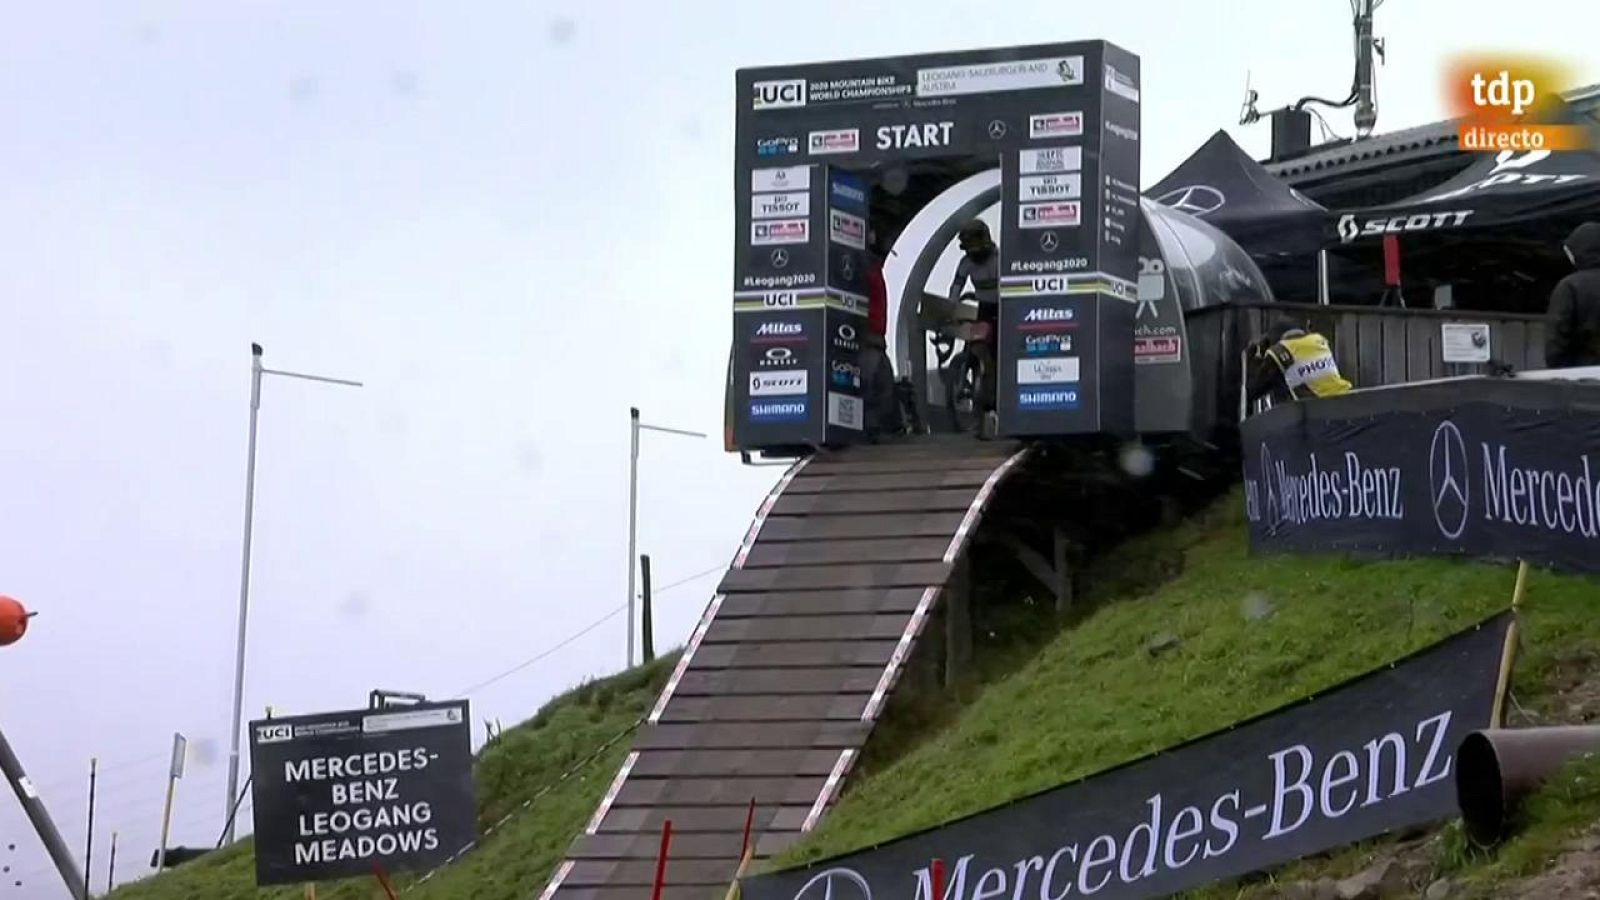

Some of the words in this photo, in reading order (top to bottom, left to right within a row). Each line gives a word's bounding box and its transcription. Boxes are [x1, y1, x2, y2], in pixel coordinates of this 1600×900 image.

[829, 79, 876, 89] MOUNTAIN
[763, 84, 802, 105] UCI
[810, 90, 841, 100] WORLD
[841, 84, 911, 99] CHAMPIONSHIPS
[876, 121, 954, 150] START
[1030, 184, 1070, 196] TISSOT
[761, 201, 800, 214] TISSOT
[1360, 209, 1475, 235] SCOTT
[1011, 258, 1088, 272] #Leogang2020
[743, 273, 816, 288] #Leogang2020
[1034, 278, 1064, 292] UCI
[764, 293, 794, 306] UCI
[1024, 308, 1074, 321] Mitas
[756, 322, 802, 335] Mitas
[1019, 391, 1077, 405] SHIMANO
[751, 403, 805, 416] SHIMANO
[263, 728, 290, 739] UCI
[284, 747, 440, 783] MERCEDES-
[332, 777, 400, 805] BENZ
[912, 710, 1453, 900] Mercedes-Benz
[299, 801, 432, 837] LEOGANG
[294, 827, 440, 865] MEADOWS
